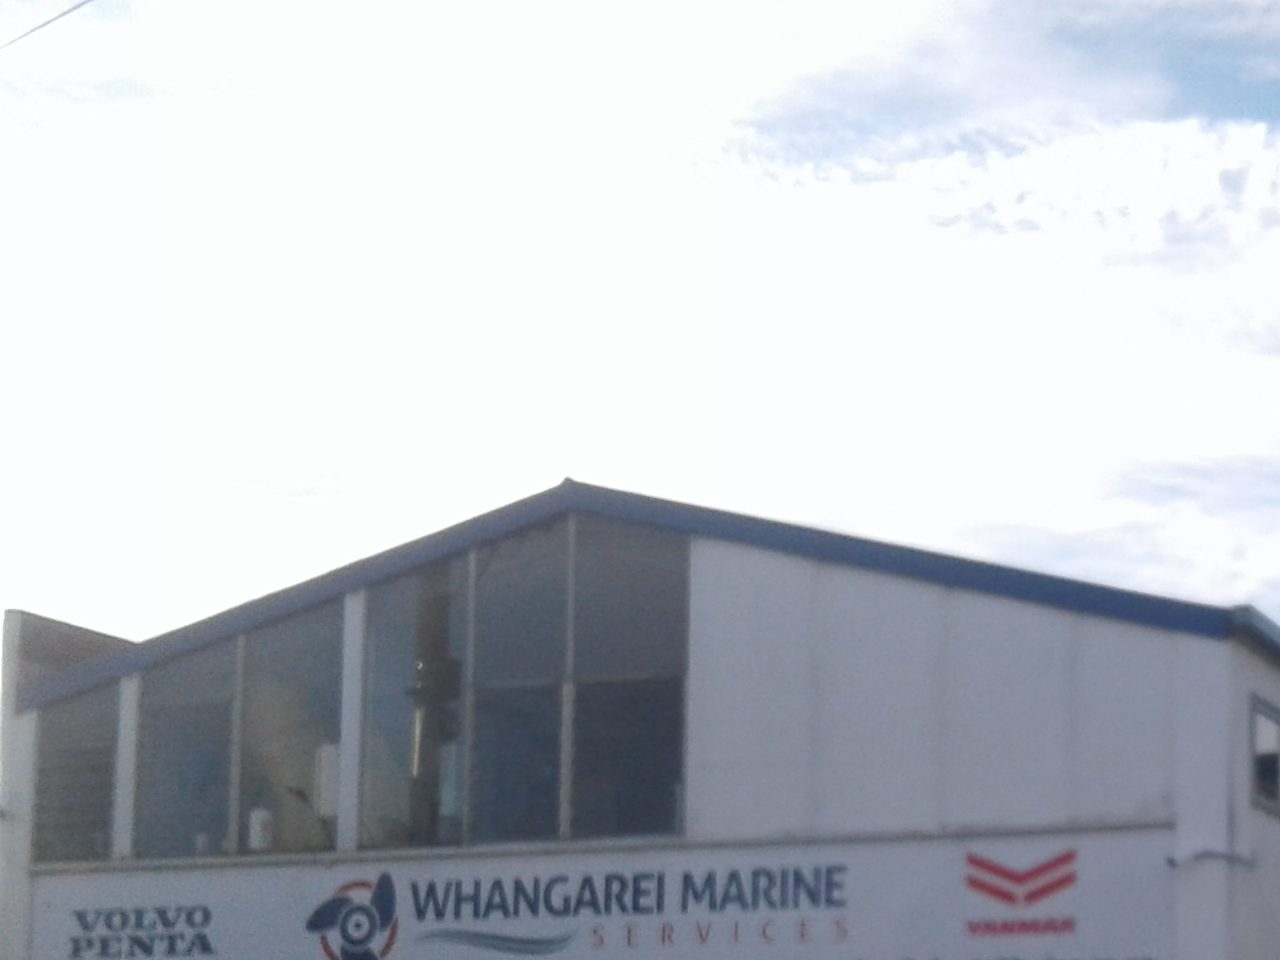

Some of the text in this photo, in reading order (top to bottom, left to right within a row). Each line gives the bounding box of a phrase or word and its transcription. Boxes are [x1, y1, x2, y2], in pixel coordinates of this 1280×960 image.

[410, 863, 849, 922] WHANGAREI MARINE
[72, 904, 213, 932] VOLVO
[592, 916, 849, 950] SERVICES
[68, 931, 216, 960] PENTA
